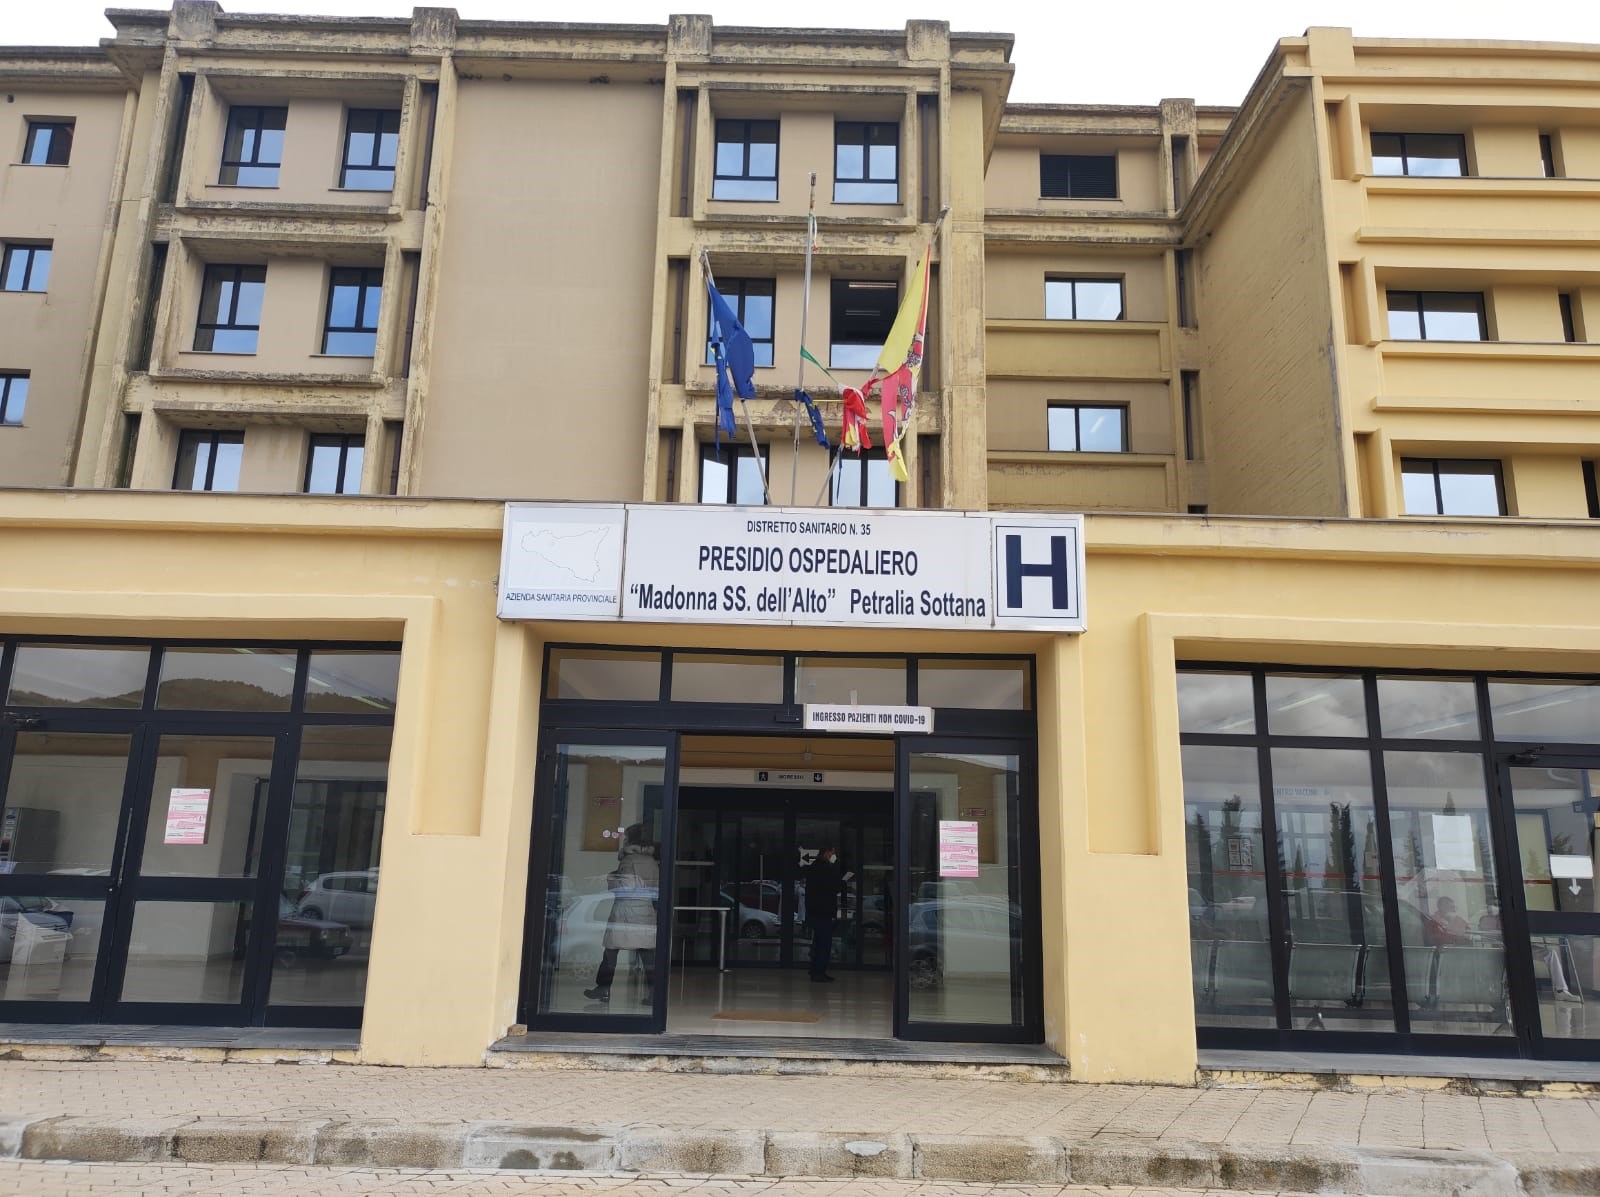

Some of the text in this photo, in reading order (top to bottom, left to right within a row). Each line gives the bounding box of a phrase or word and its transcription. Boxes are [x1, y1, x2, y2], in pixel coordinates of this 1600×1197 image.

[747, 520, 871, 536] DISTRETTO SANITARIO N. 35
[698, 545, 918, 577] PRESIDIO OSPEDALIERO
[1006, 534, 1069, 610] H
[506, 592, 617, 604] AZIENDA SANITARIA PROVINCIALE
[723, 585, 751, 612] SS.
[850, 588, 914, 616] Petralia
[920, 590, 986, 618] Sottana
[812, 711, 926, 725] INGRESSO PAZIENTI NON COVID-19
